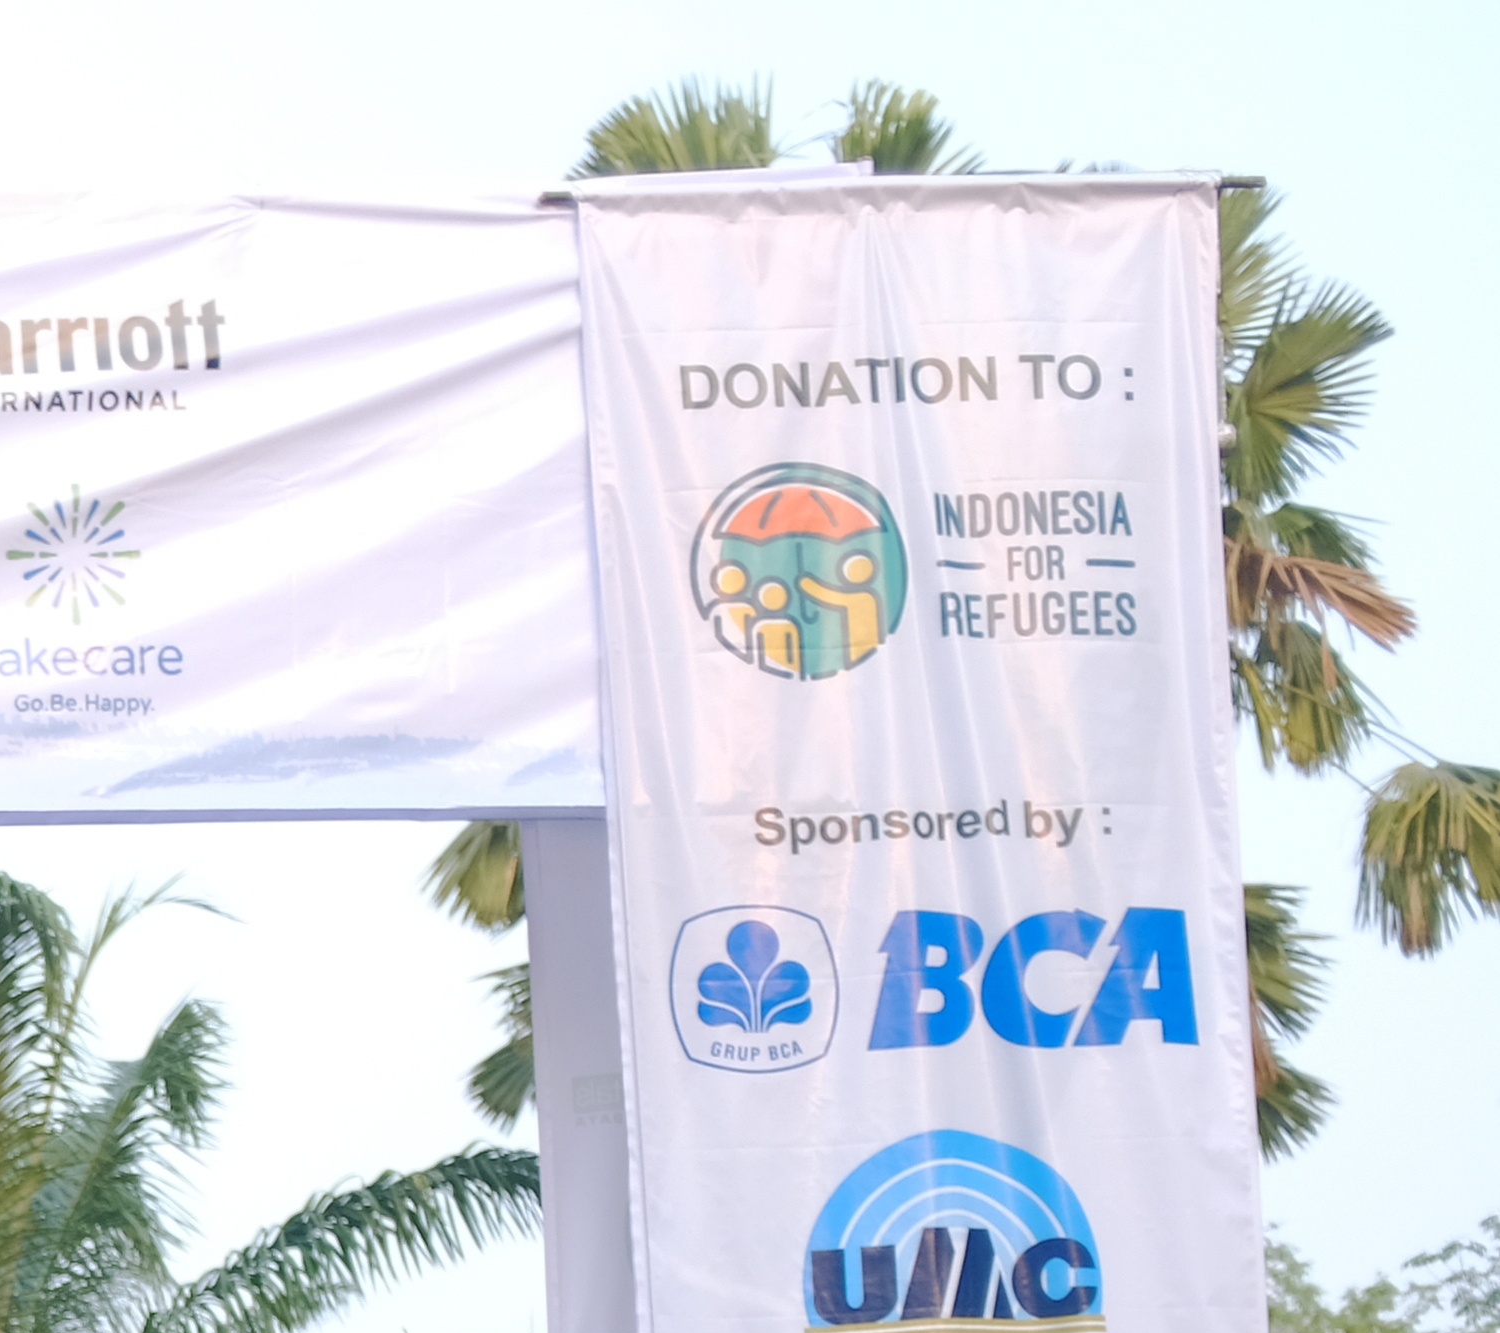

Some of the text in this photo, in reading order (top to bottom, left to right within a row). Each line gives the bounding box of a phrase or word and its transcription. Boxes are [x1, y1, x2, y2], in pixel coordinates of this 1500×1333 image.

[680, 353, 1102, 410] DONATION TO
[934, 490, 1133, 539] INDONESIA
[1007, 545, 1065, 582] FOR
[940, 591, 1137, 639] REFUGEES
[754, 799, 1084, 855] Sponsored by
[867, 907, 1199, 1051] BCA
[710, 1039, 803, 1064] GRUP BCA
